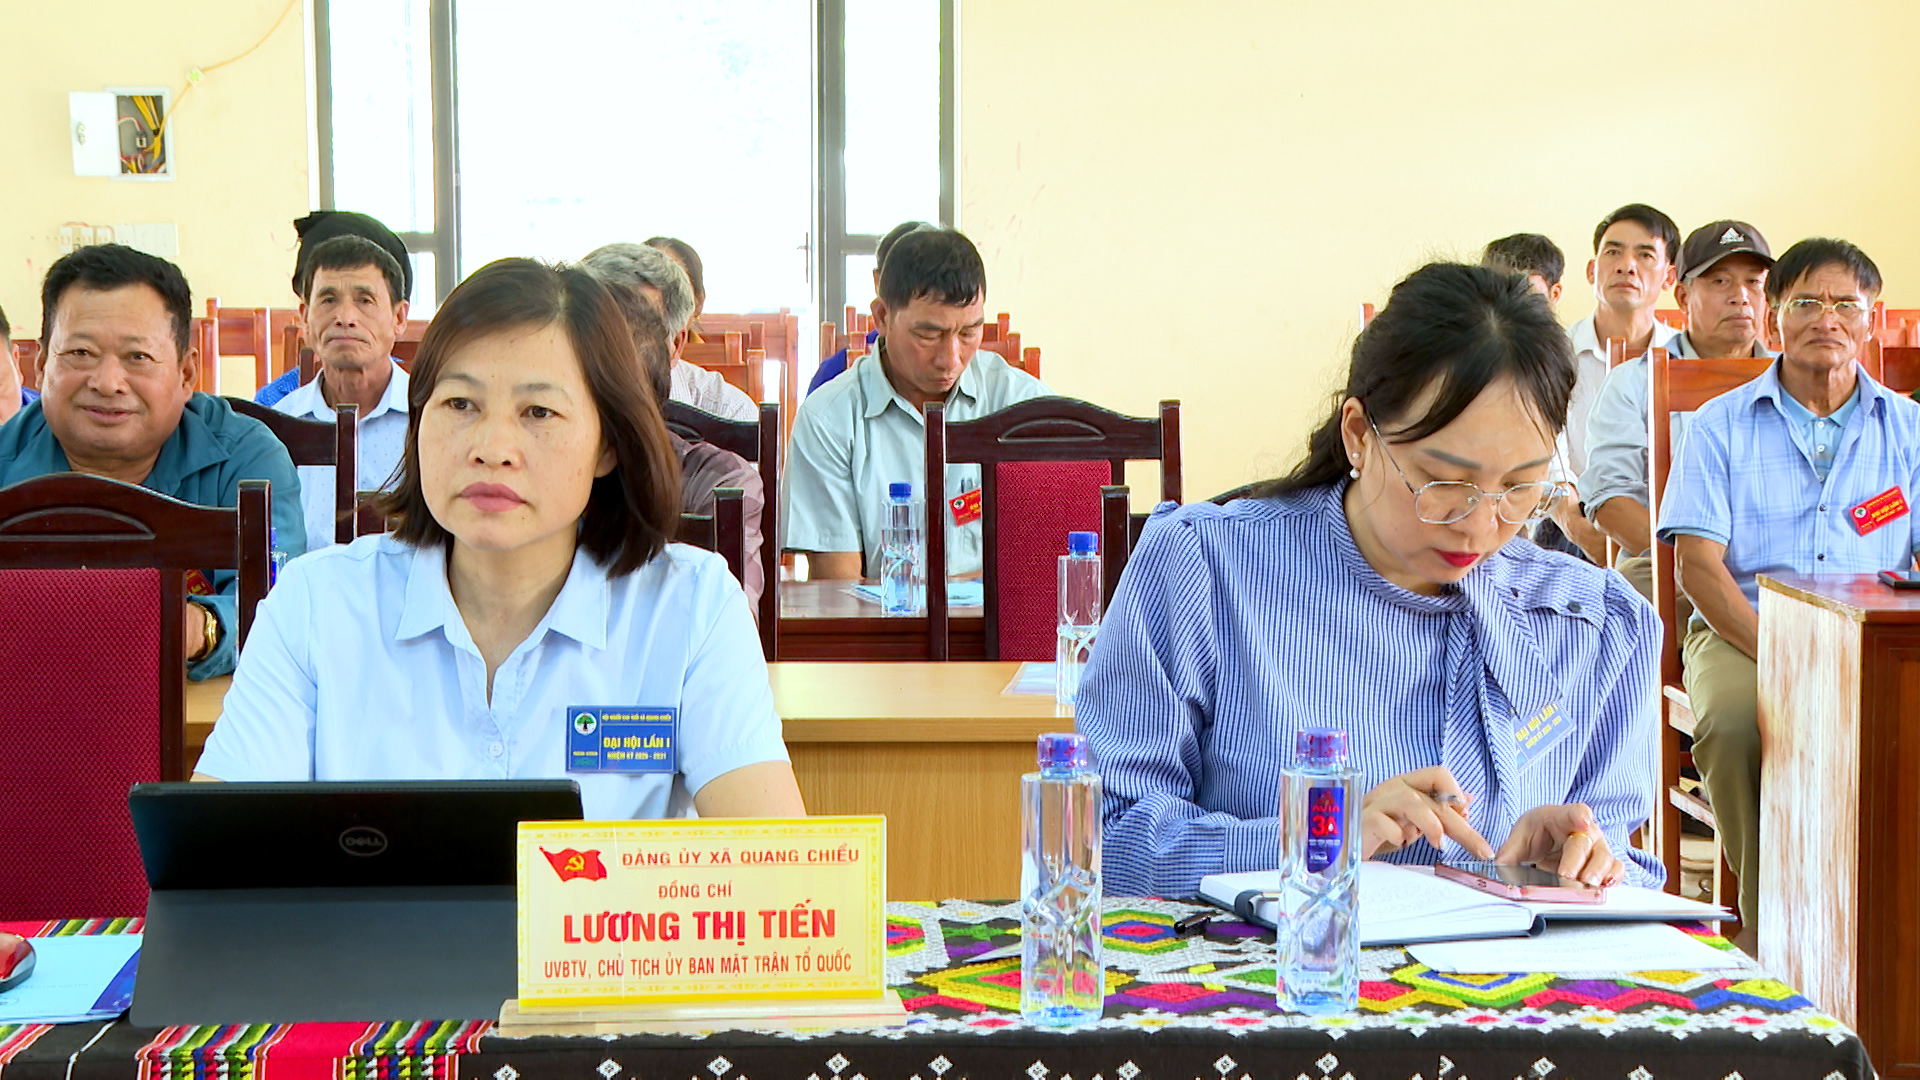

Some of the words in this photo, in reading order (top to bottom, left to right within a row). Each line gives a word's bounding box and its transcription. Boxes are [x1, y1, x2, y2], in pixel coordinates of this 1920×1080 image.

[603, 737, 621, 749] ĐẠI
[623, 735, 641, 749] HỘI
[345, 837, 383, 847] DELL
[622, 847, 671, 866] ĐẢNG
[679, 847, 702, 864] ỦY
[710, 847, 731, 864] XÃ
[740, 849, 799, 864] QUANG
[707, 880, 733, 898] CHÍ
[563, 910, 681, 944] LƯƠNG
[692, 910, 746, 947] THỊ
[758, 898, 836, 939] TIẾN
[544, 959, 592, 979] UVBTV,
[598, 952, 624, 976] CHỦ
[630, 958, 660, 979] TỊCH
[665, 951, 683, 976] ỦY
[689, 957, 714, 975] BAN
[754, 950, 789, 976] TRẬN
[795, 945, 811, 972] TỔ
[817, 947, 852, 972] QUỐC
